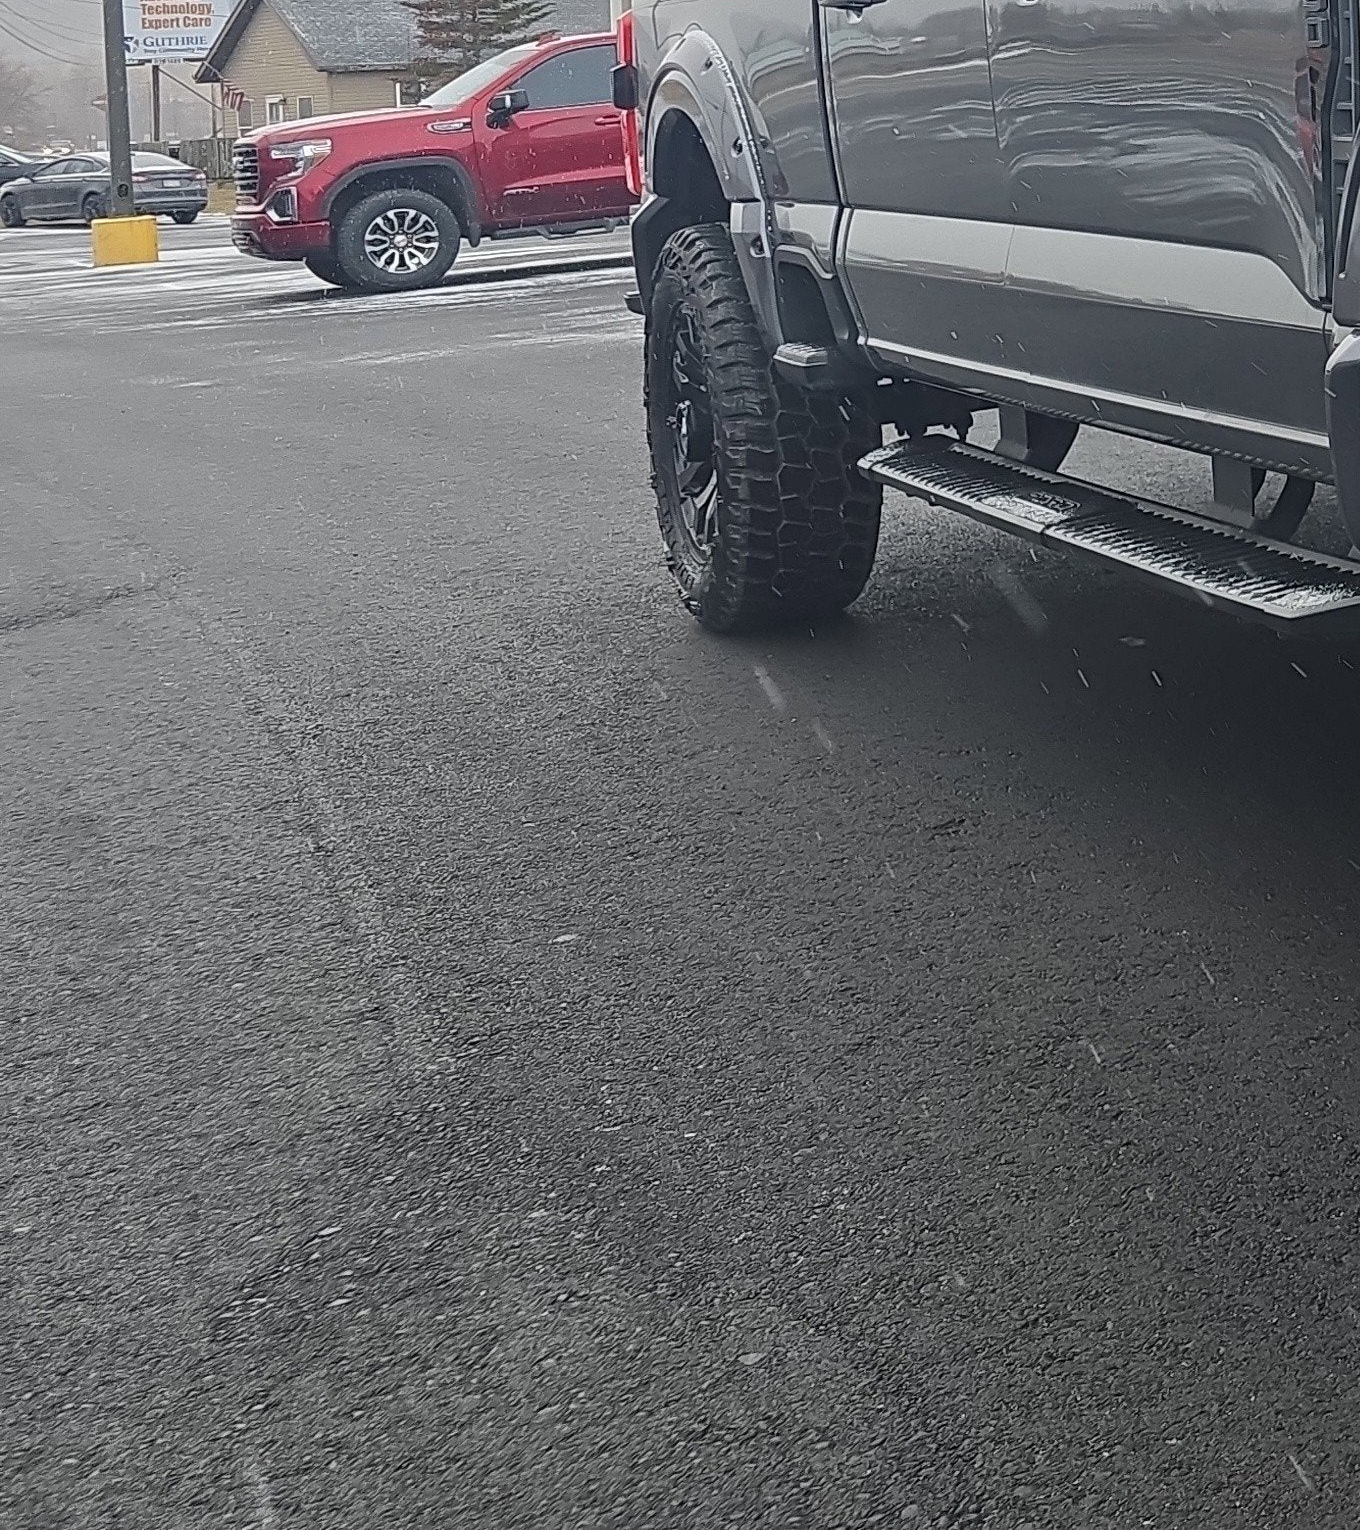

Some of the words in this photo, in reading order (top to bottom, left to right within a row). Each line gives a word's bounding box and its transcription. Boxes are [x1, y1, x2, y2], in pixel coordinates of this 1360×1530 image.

[142, 2, 214, 16] Technology,
[142, 17, 180, 30] Expert
[183, 16, 212, 28] Care
[143, 36, 208, 47] GUTHRIE
